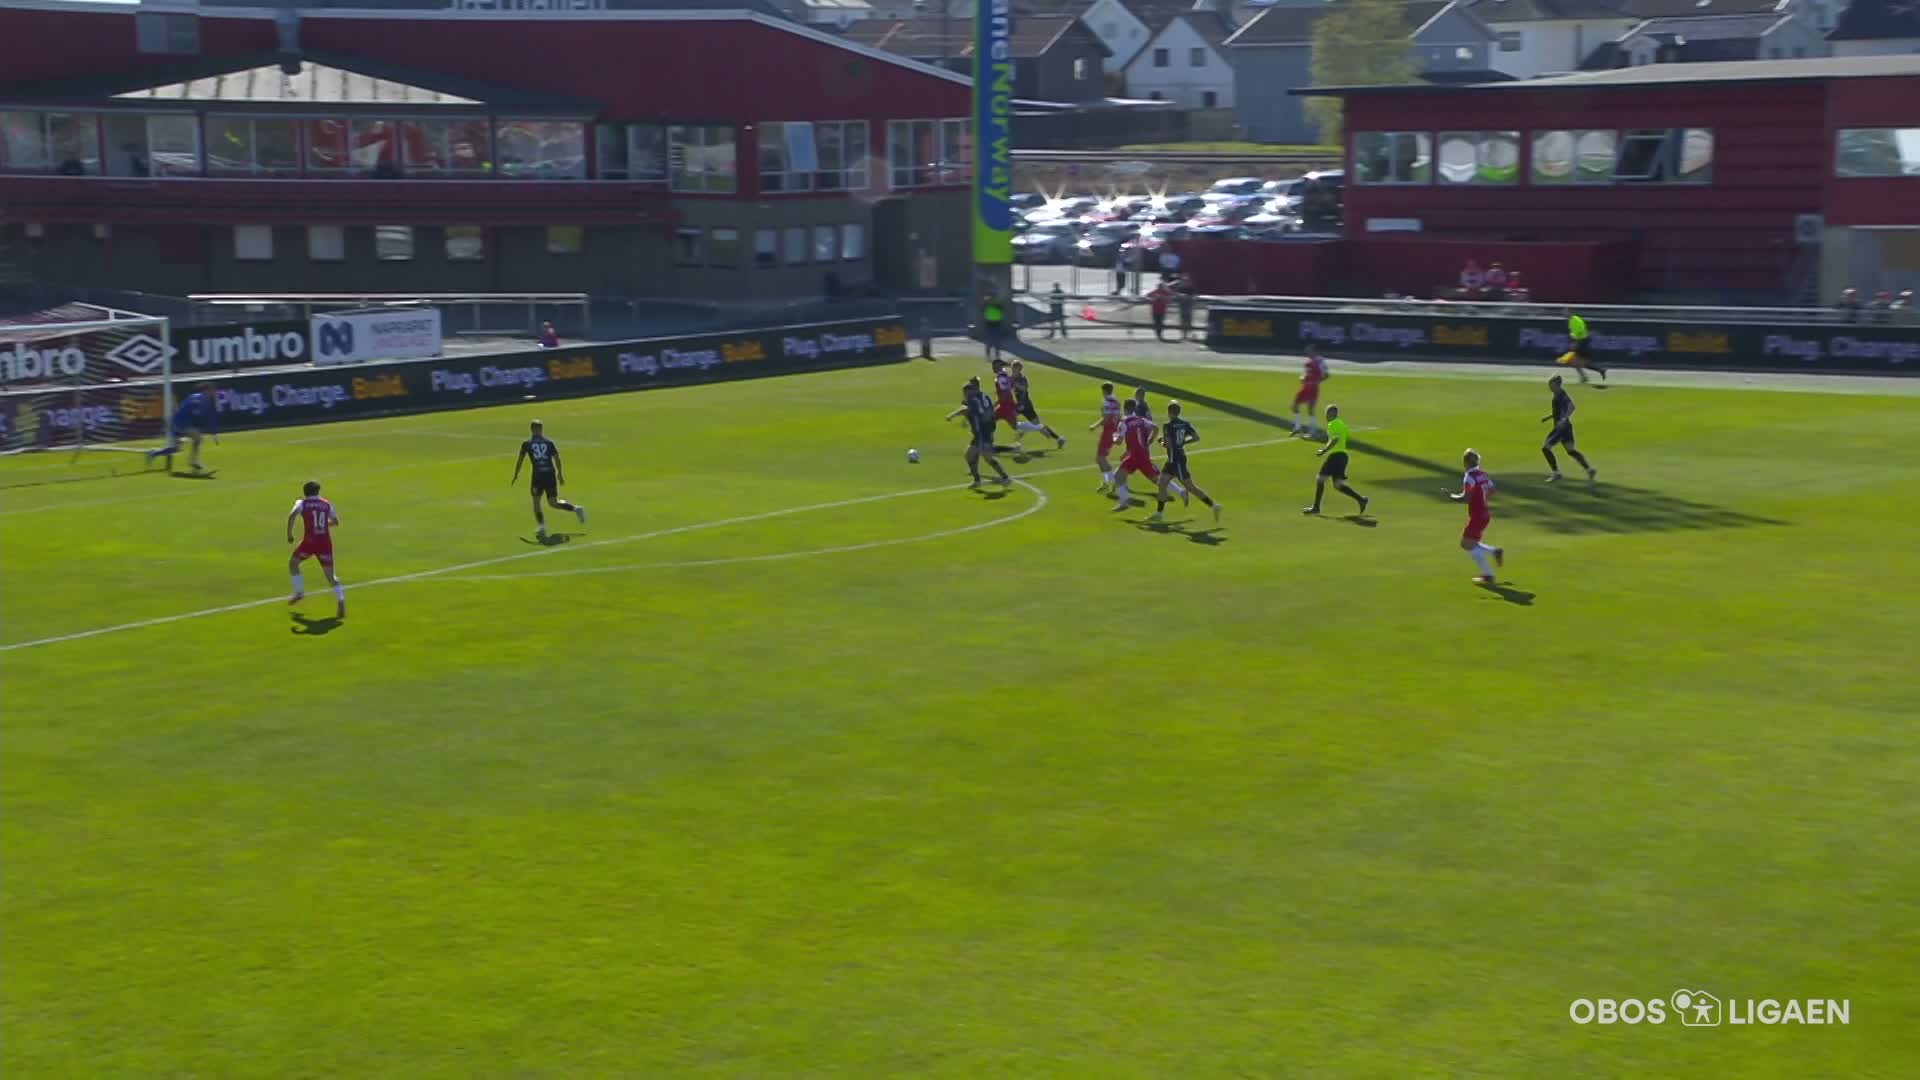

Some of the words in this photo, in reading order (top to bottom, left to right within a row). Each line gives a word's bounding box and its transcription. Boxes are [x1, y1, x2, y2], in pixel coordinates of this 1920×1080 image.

[190, 328, 303, 365] umbro
[215, 386, 268, 414] Plug.
[272, 383, 350, 409] Charge.
[480, 365, 546, 388] Charge.
[660, 349, 721, 371] Charge.
[530, 442, 548, 460] 32
[311, 510, 326, 529] 14
